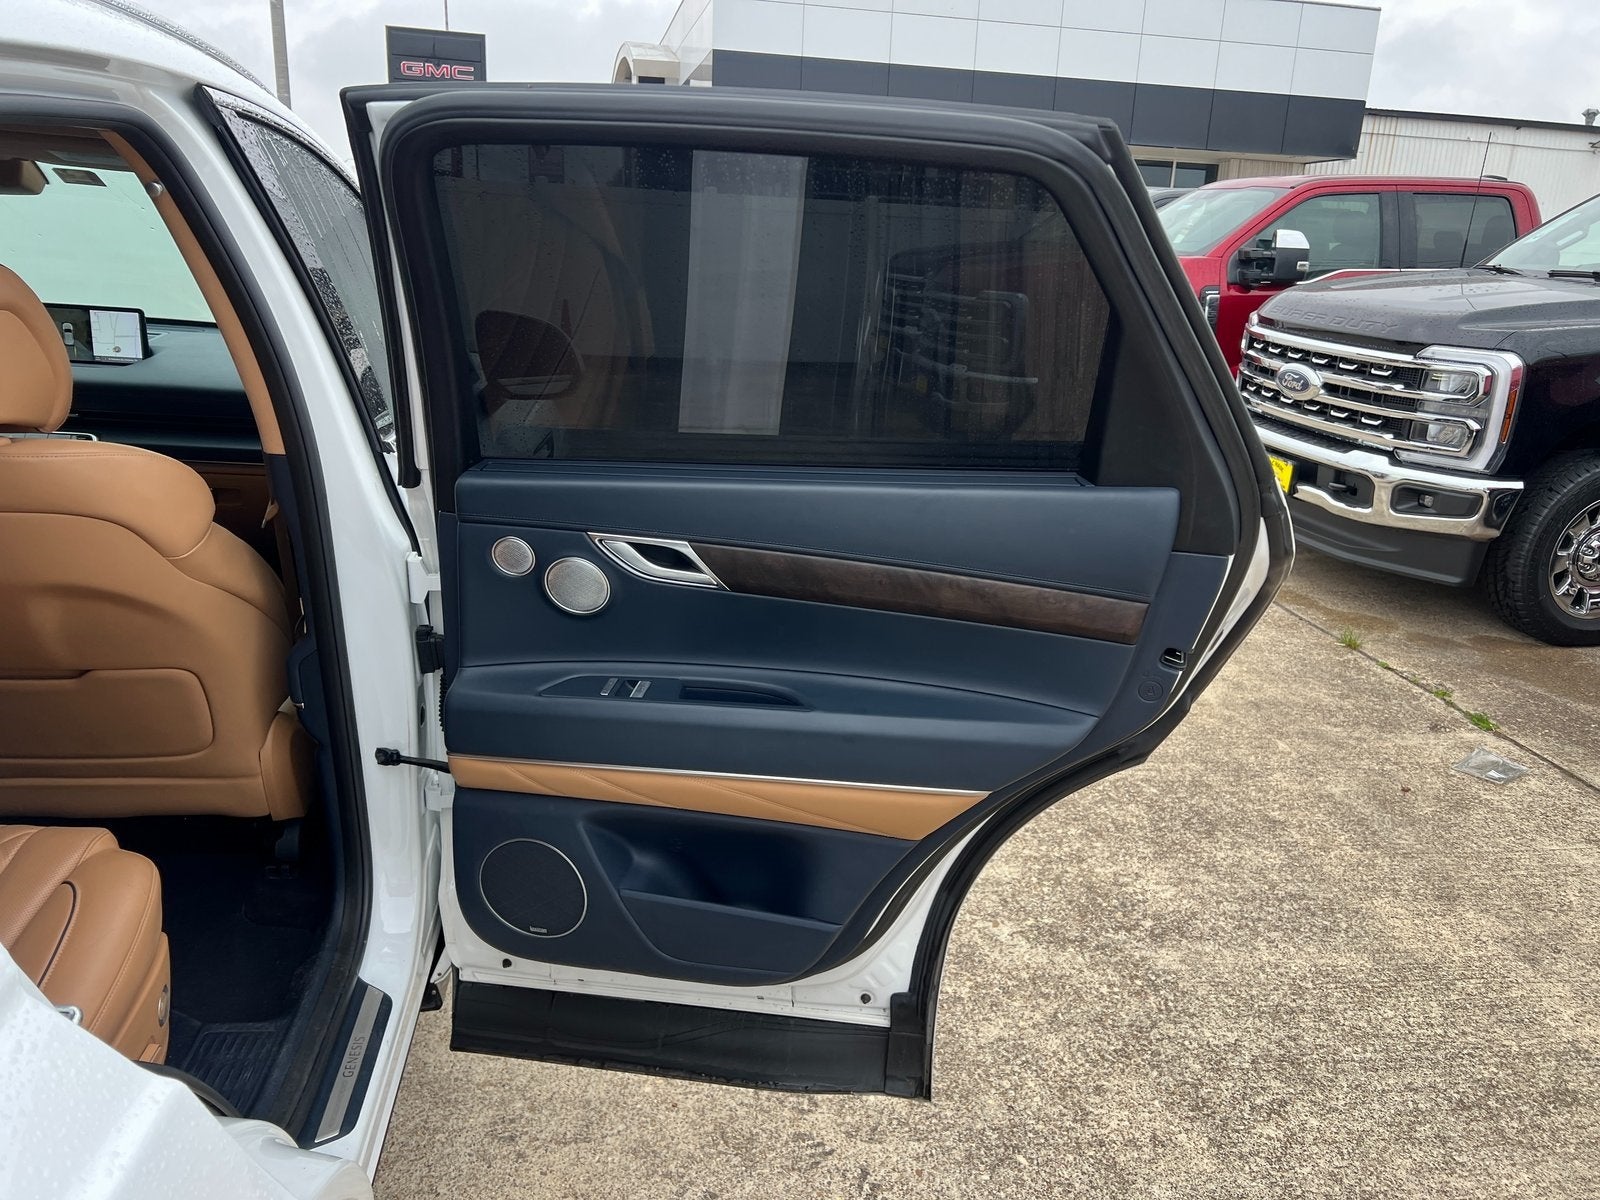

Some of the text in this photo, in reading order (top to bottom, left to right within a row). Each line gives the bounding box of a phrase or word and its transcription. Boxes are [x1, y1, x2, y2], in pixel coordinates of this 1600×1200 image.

[401, 61, 474, 80] GMC
[1271, 304, 1399, 333] SUPER DUTY
[1282, 372, 1304, 390] Ford
[342, 1036, 367, 1077] GENESIS
